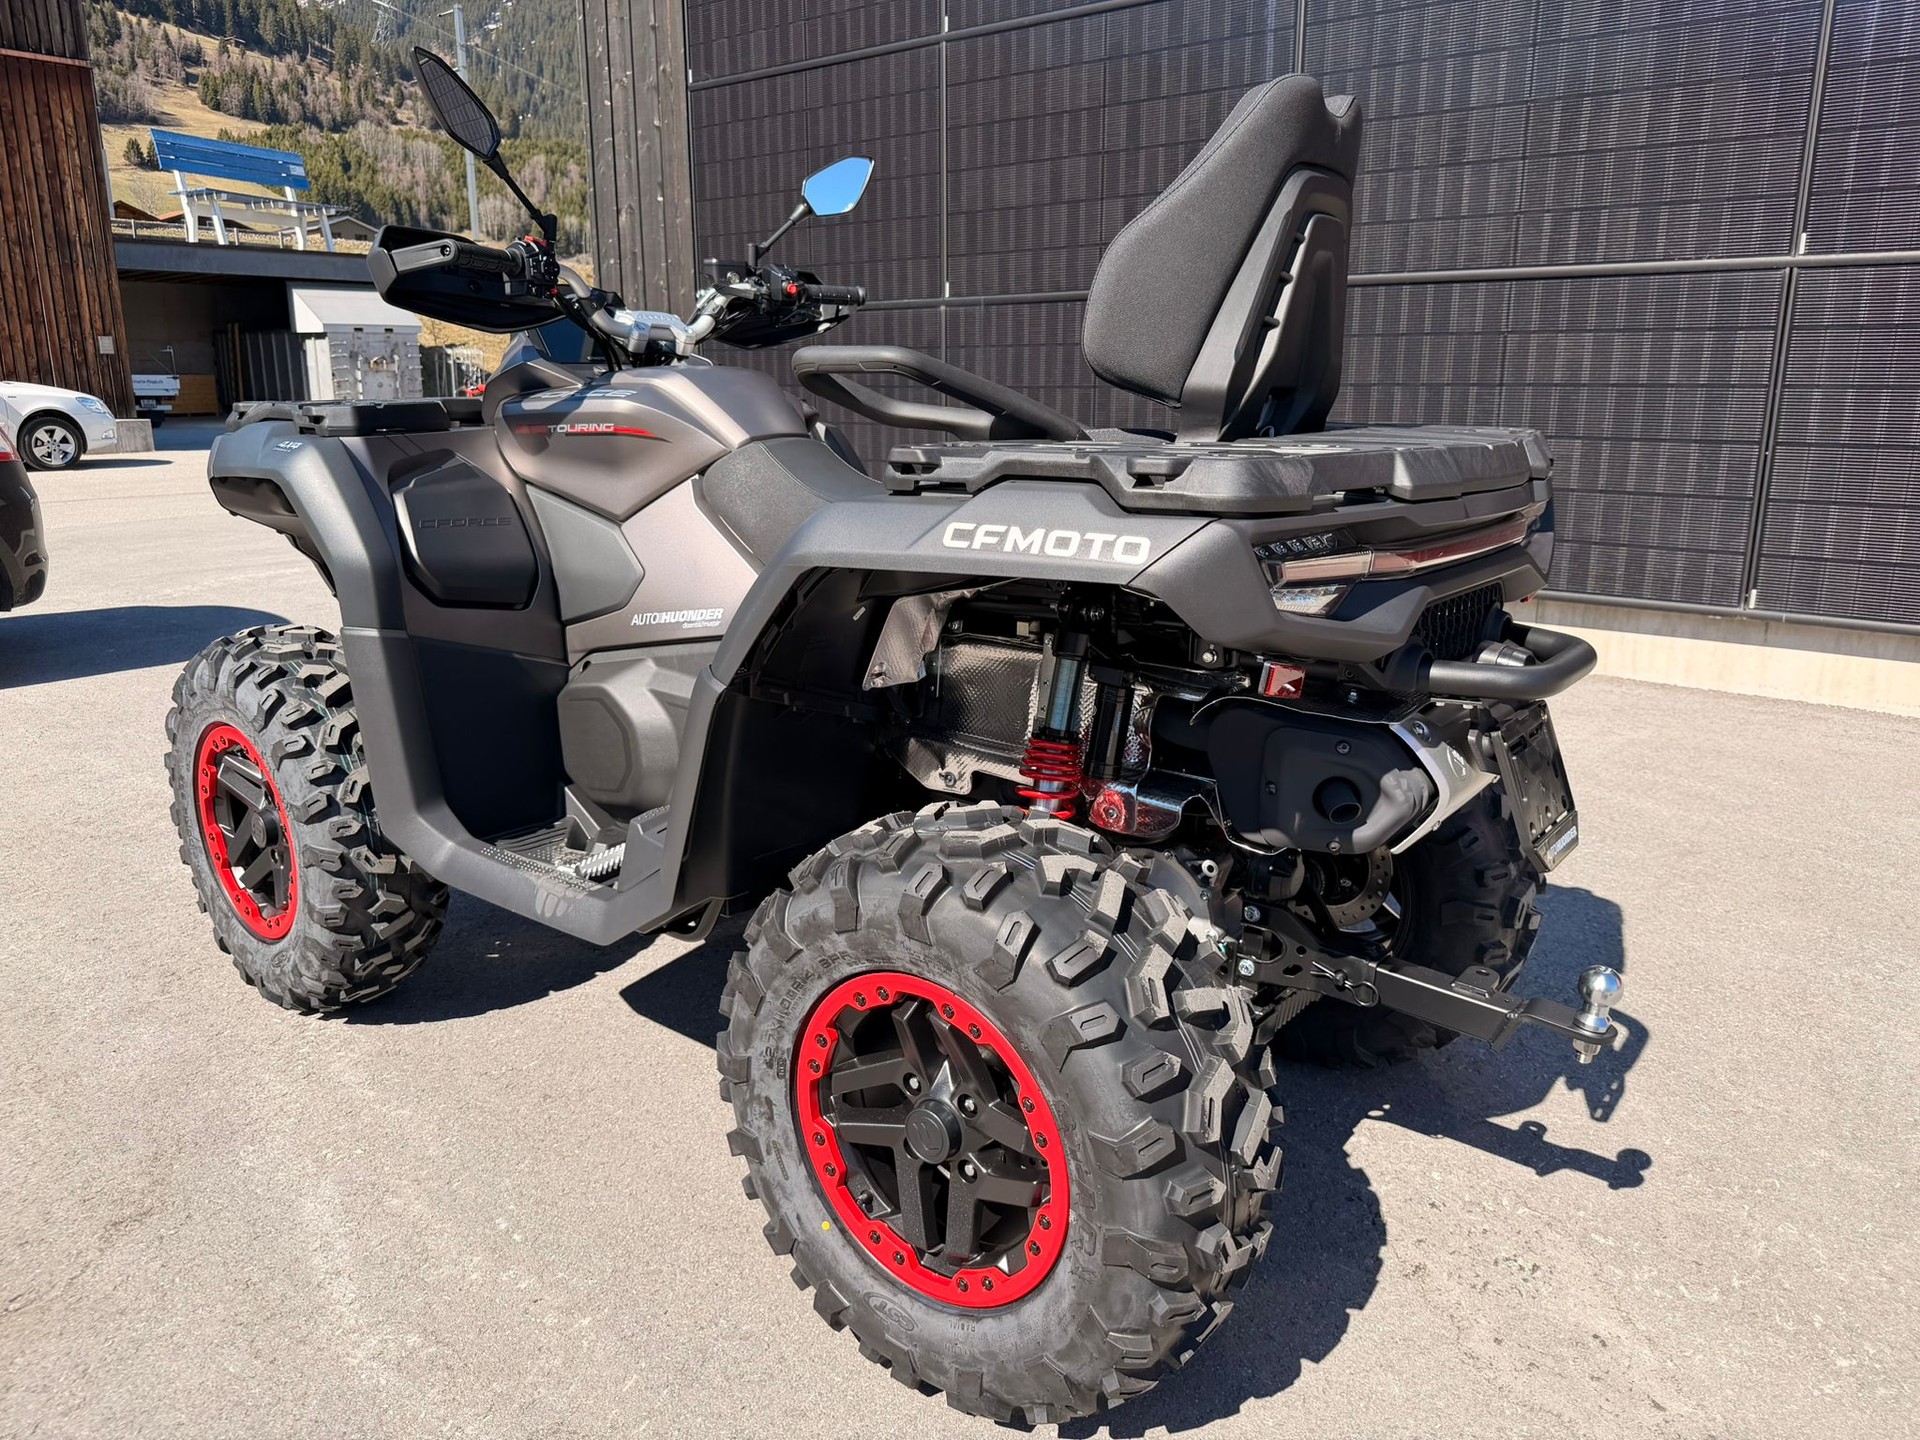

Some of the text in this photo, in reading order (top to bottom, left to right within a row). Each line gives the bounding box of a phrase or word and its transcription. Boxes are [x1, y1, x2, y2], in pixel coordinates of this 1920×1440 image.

[547, 423, 615, 434] TOURING
[418, 516, 513, 529] CFORCE
[942, 521, 1151, 565] CFMOTO
[873, 1301, 915, 1333] CST
